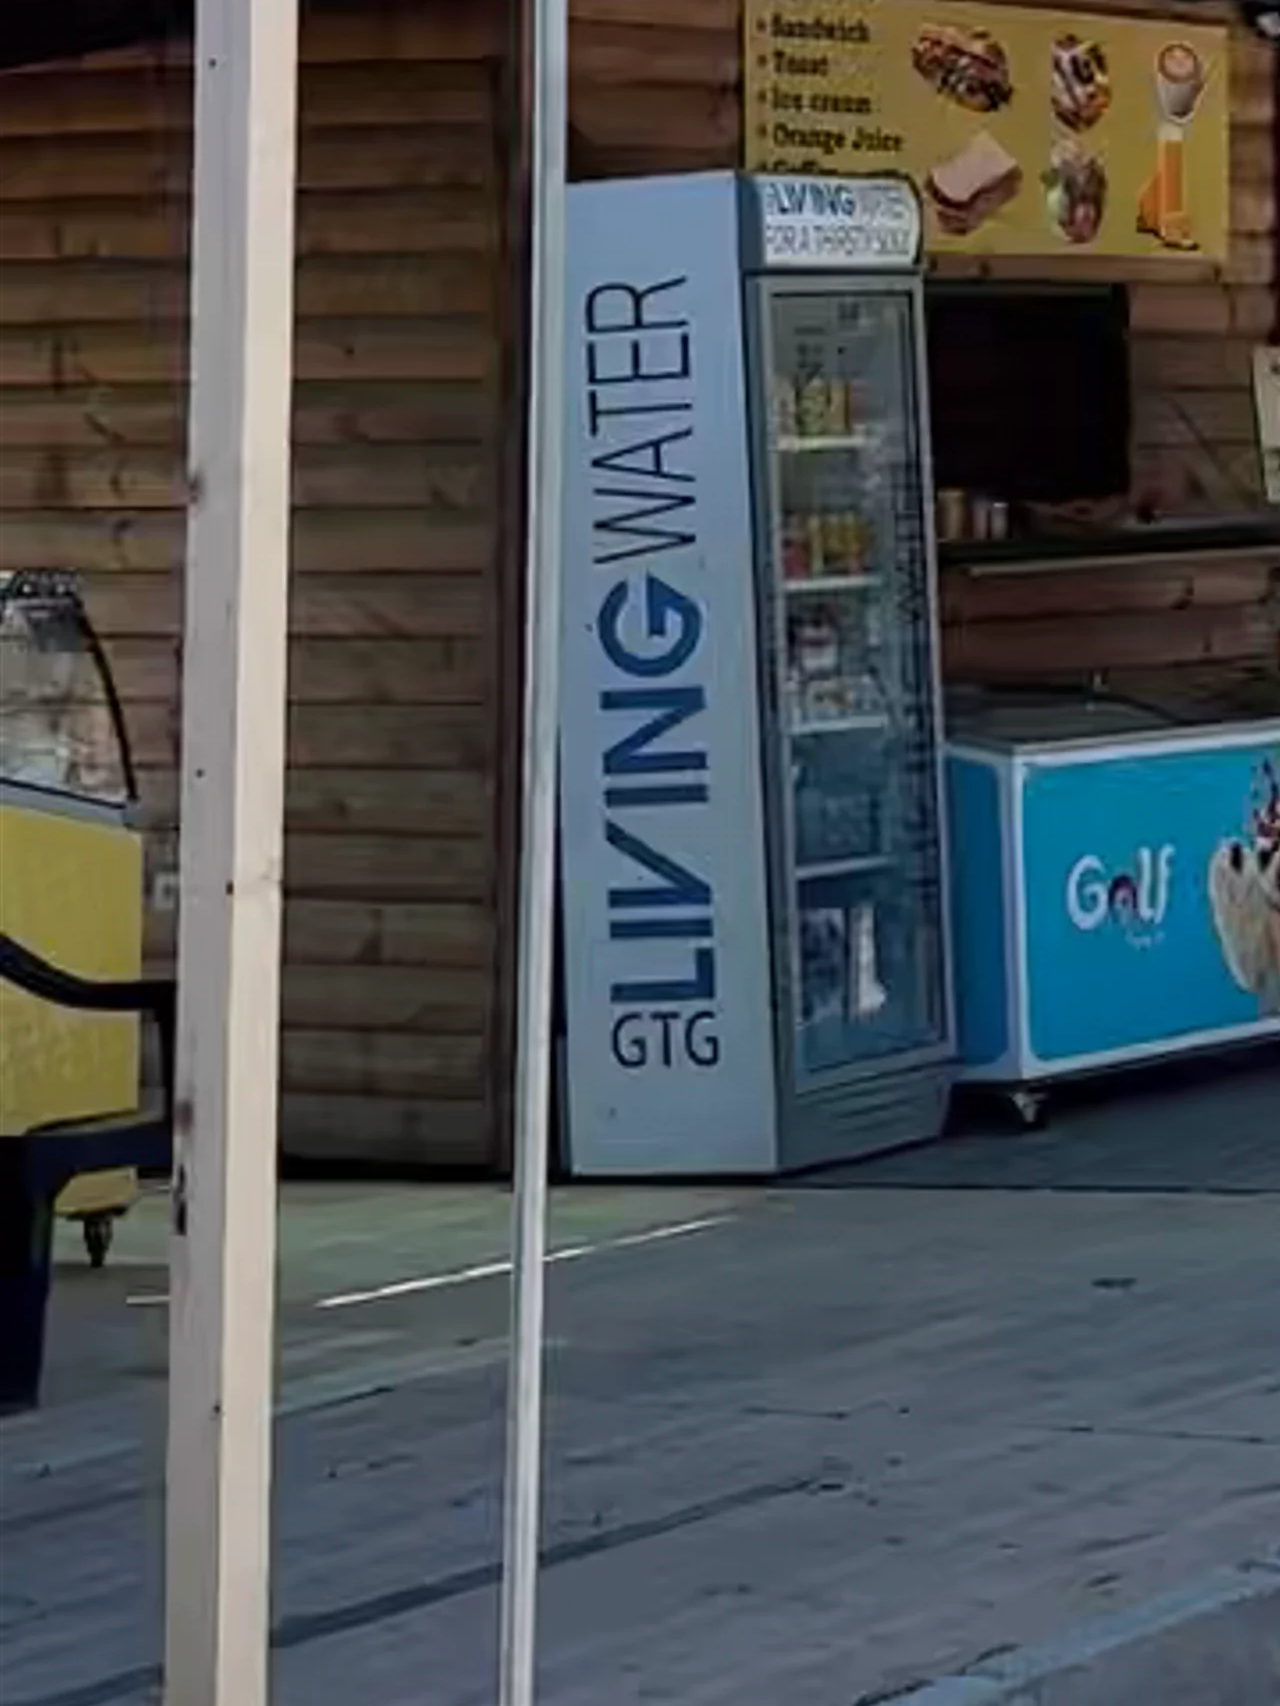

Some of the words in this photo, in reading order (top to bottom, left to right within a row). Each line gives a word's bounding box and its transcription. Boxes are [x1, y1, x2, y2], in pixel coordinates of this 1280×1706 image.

[773, 50, 828, 76] Toast
[773, 123, 845, 155] Orange
[587, 274, 697, 565] WATER
[599, 572, 715, 1003] LIVING
[1066, 843, 1175, 930] Golf
[612, 1010, 719, 1067] GTG
